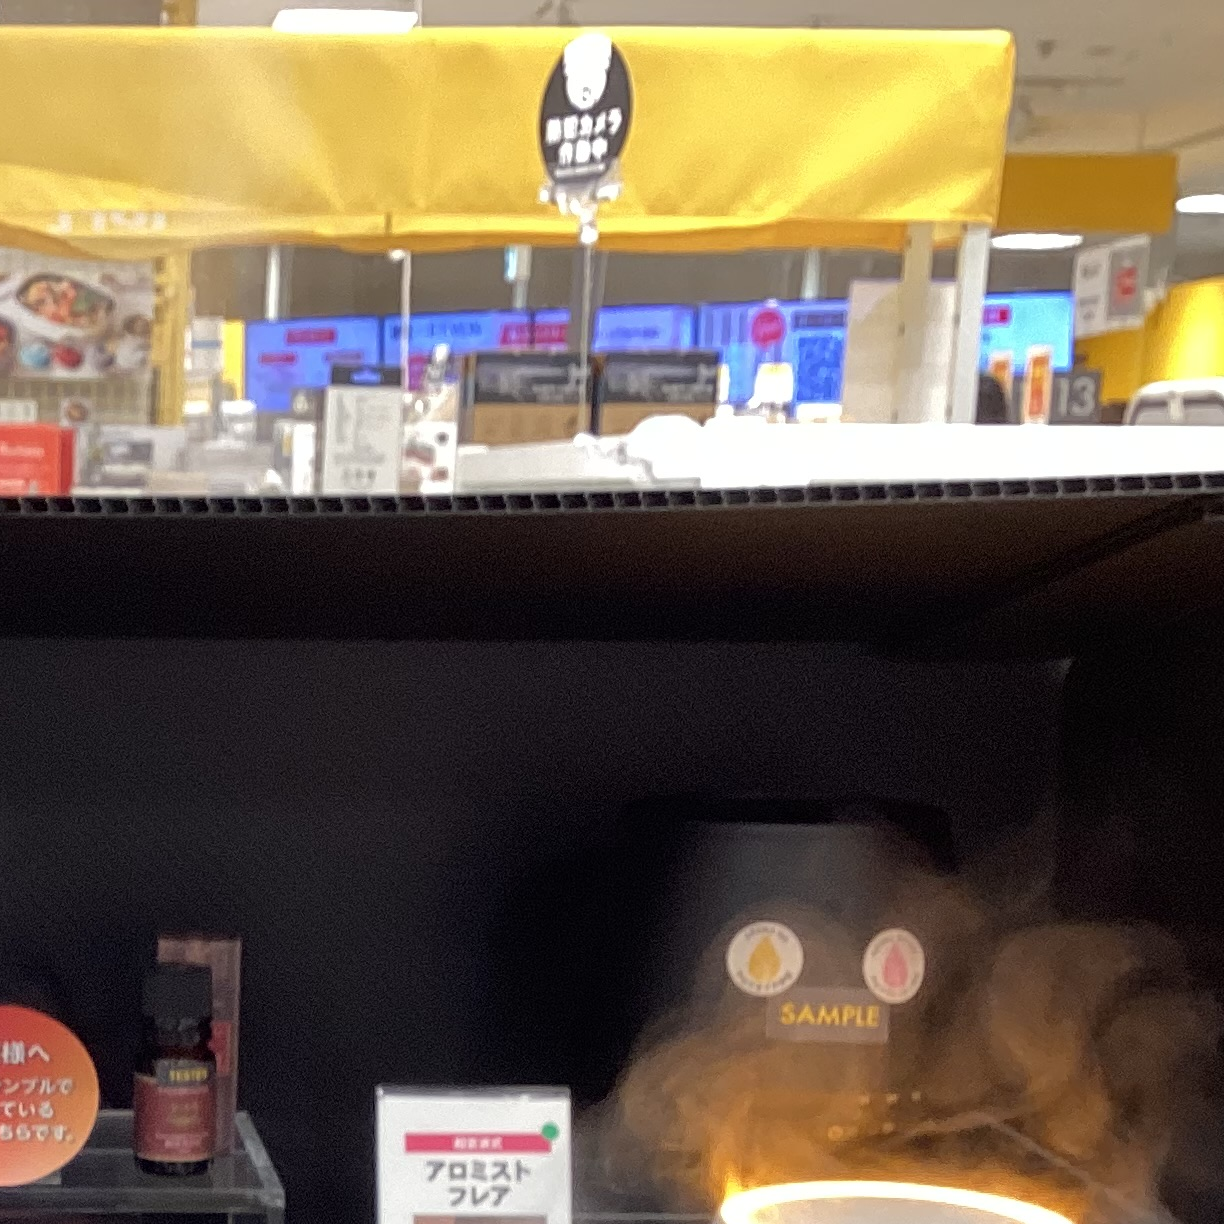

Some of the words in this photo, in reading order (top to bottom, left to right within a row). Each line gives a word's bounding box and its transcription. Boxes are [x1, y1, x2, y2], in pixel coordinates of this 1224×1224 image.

[780, 1001, 881, 1028] SAMPLE
[426, 1161, 531, 1182] アロミスト
[448, 1186, 511, 1207] フレア
